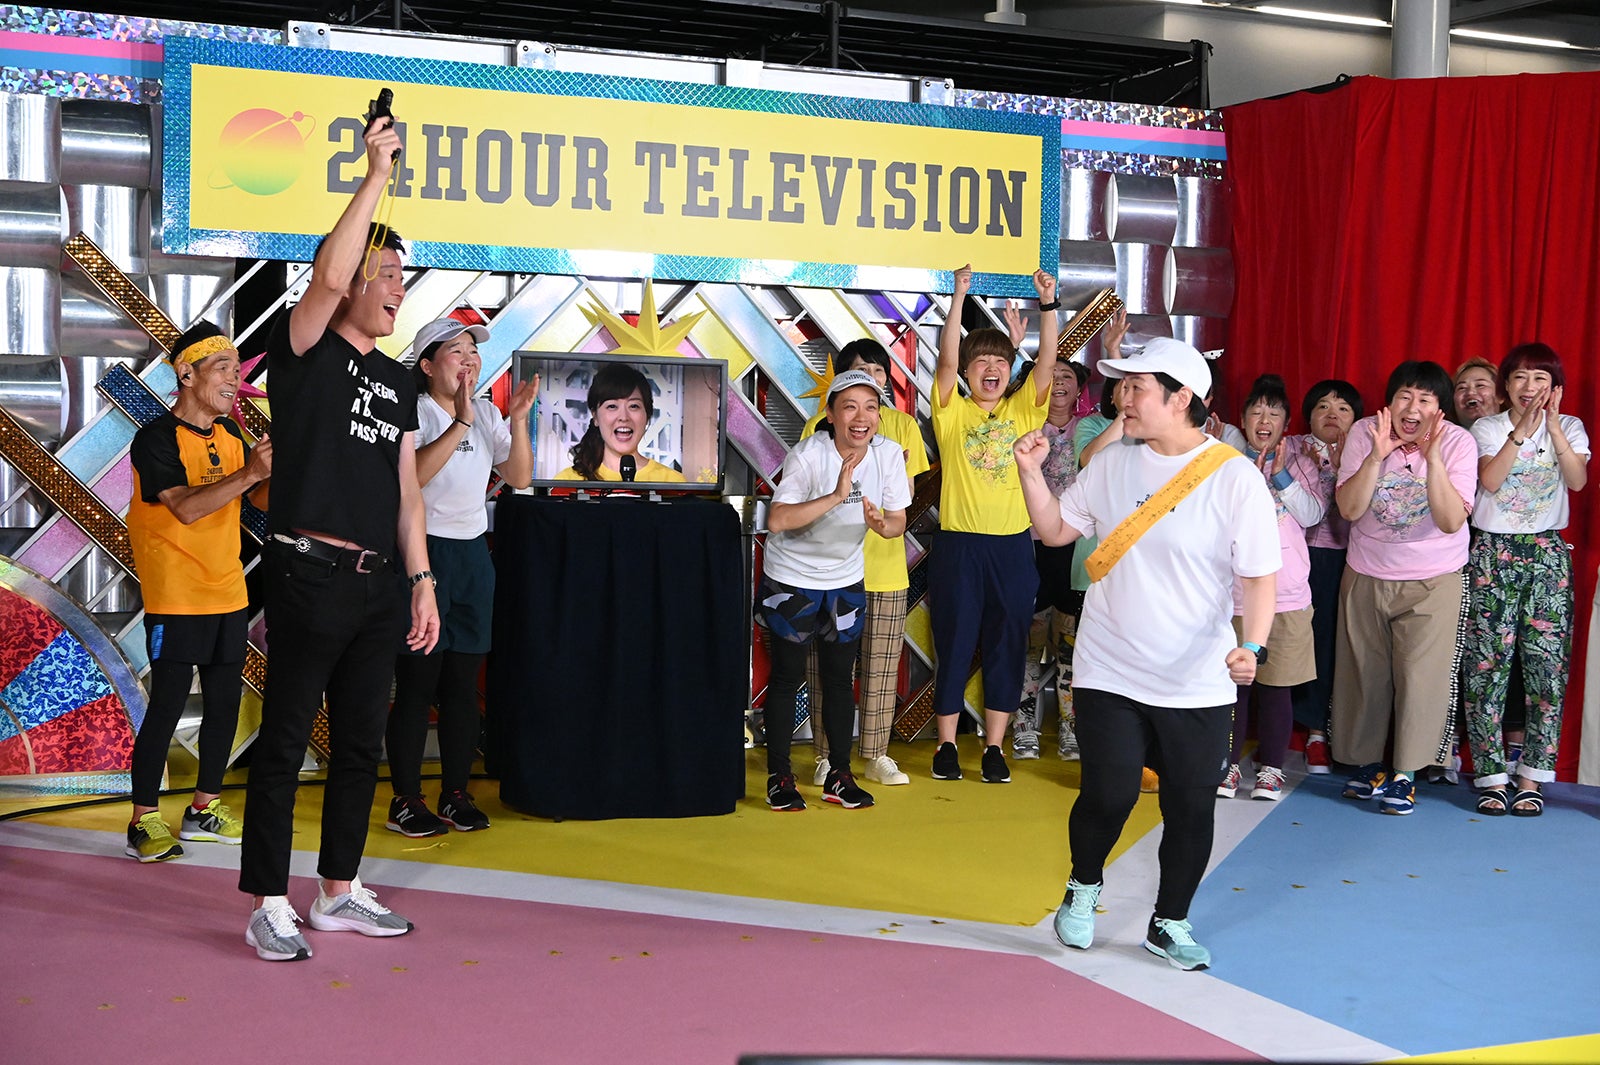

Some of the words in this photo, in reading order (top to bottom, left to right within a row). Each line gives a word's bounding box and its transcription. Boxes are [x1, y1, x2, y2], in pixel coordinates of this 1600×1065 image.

[327, 117, 612, 212] 24HOUR
[635, 140, 1028, 238] TELEVISION
[349, 419, 379, 444] PASS
